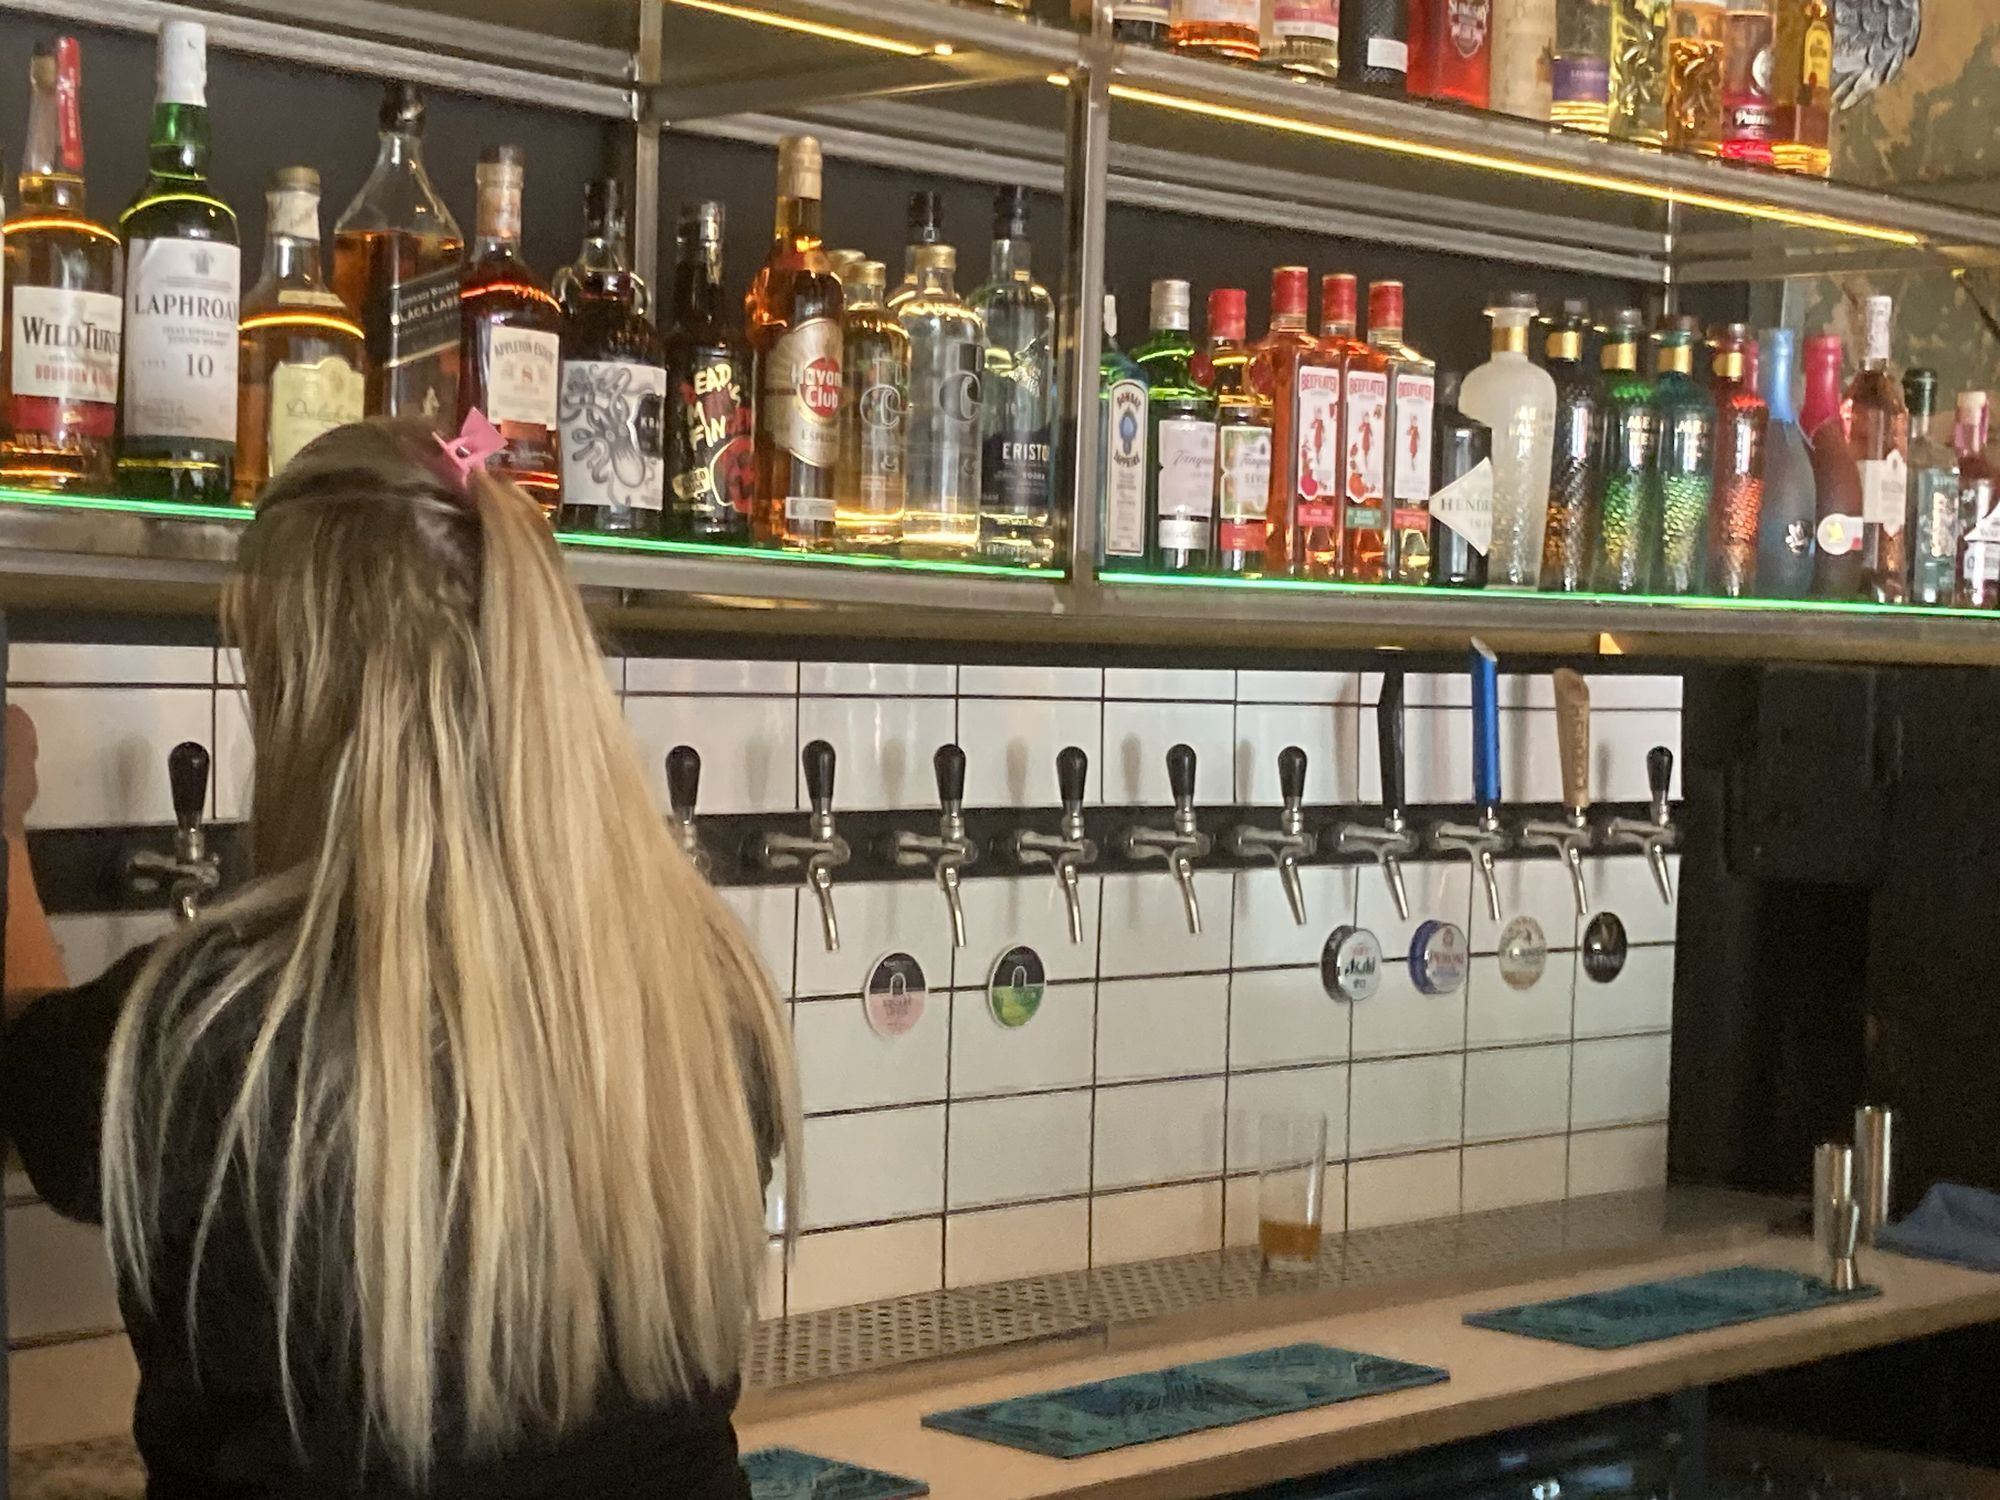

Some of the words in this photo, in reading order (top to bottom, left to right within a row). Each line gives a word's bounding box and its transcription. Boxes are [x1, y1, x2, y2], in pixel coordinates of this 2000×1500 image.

[22, 315, 81, 348] WILD
[187, 353, 214, 379] 10
[805, 386, 839, 411] Club
